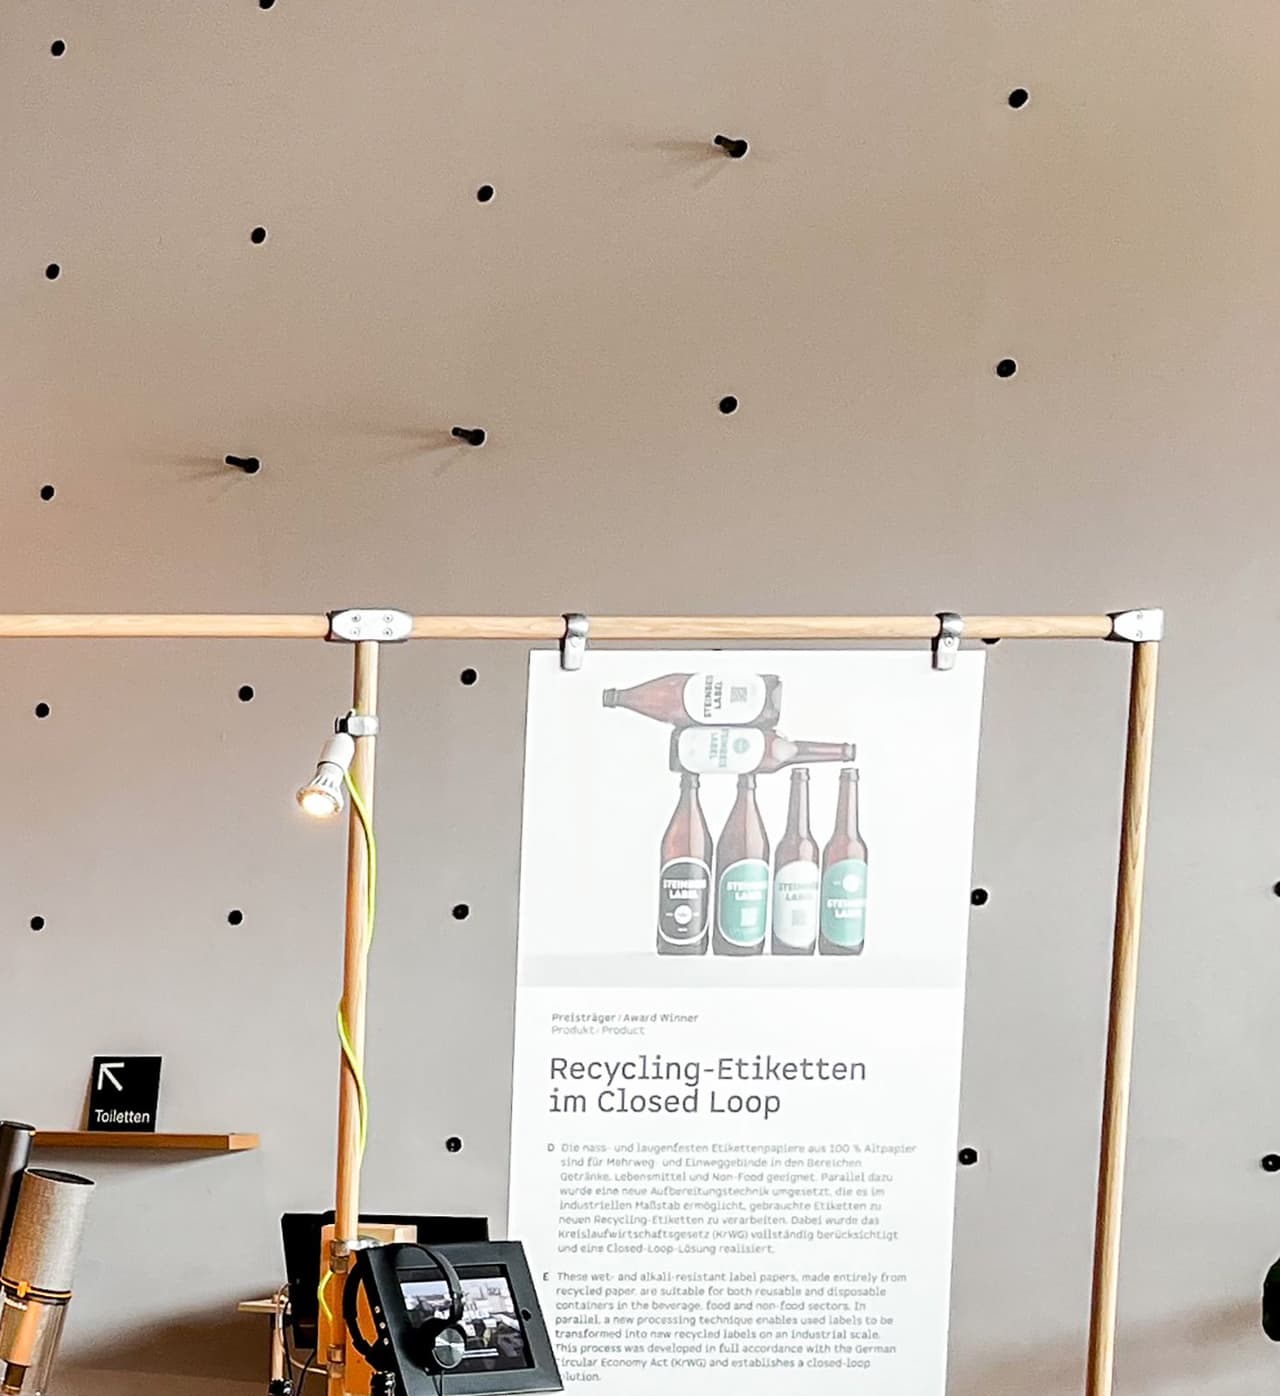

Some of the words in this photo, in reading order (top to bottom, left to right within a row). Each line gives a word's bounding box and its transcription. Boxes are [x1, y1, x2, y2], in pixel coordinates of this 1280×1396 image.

[550, 1055, 866, 1086] Recycling-Etiketten
[94, 1108, 151, 1124] Toiletten
[549, 1088, 586, 1112] im
[597, 1088, 698, 1112] Closed
[710, 1091, 780, 1119] Loop
